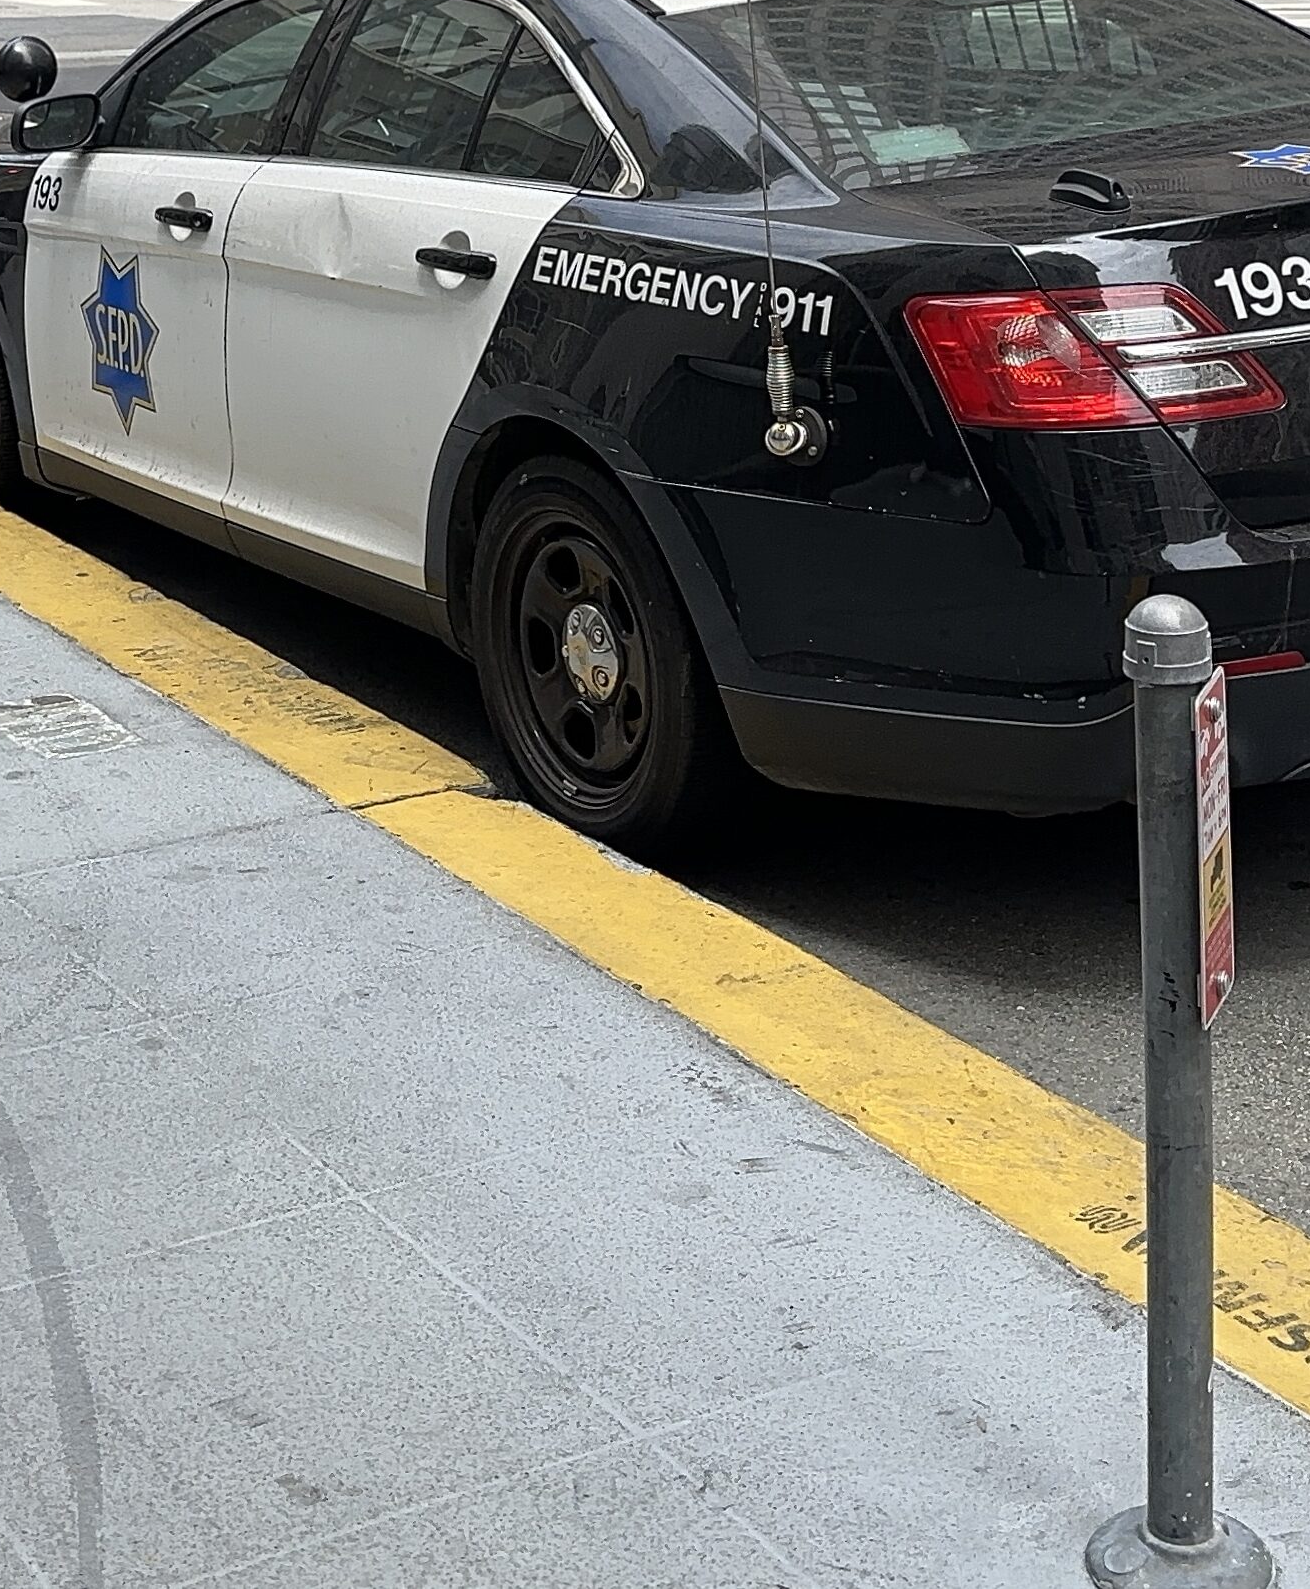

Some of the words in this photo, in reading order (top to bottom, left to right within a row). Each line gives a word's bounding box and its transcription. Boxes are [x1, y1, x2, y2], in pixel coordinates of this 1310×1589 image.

[31, 173, 63, 213] 193
[531, 245, 756, 320] EMERGENCY
[753, 282, 767, 328] DIAL
[770, 286, 834, 336] 911
